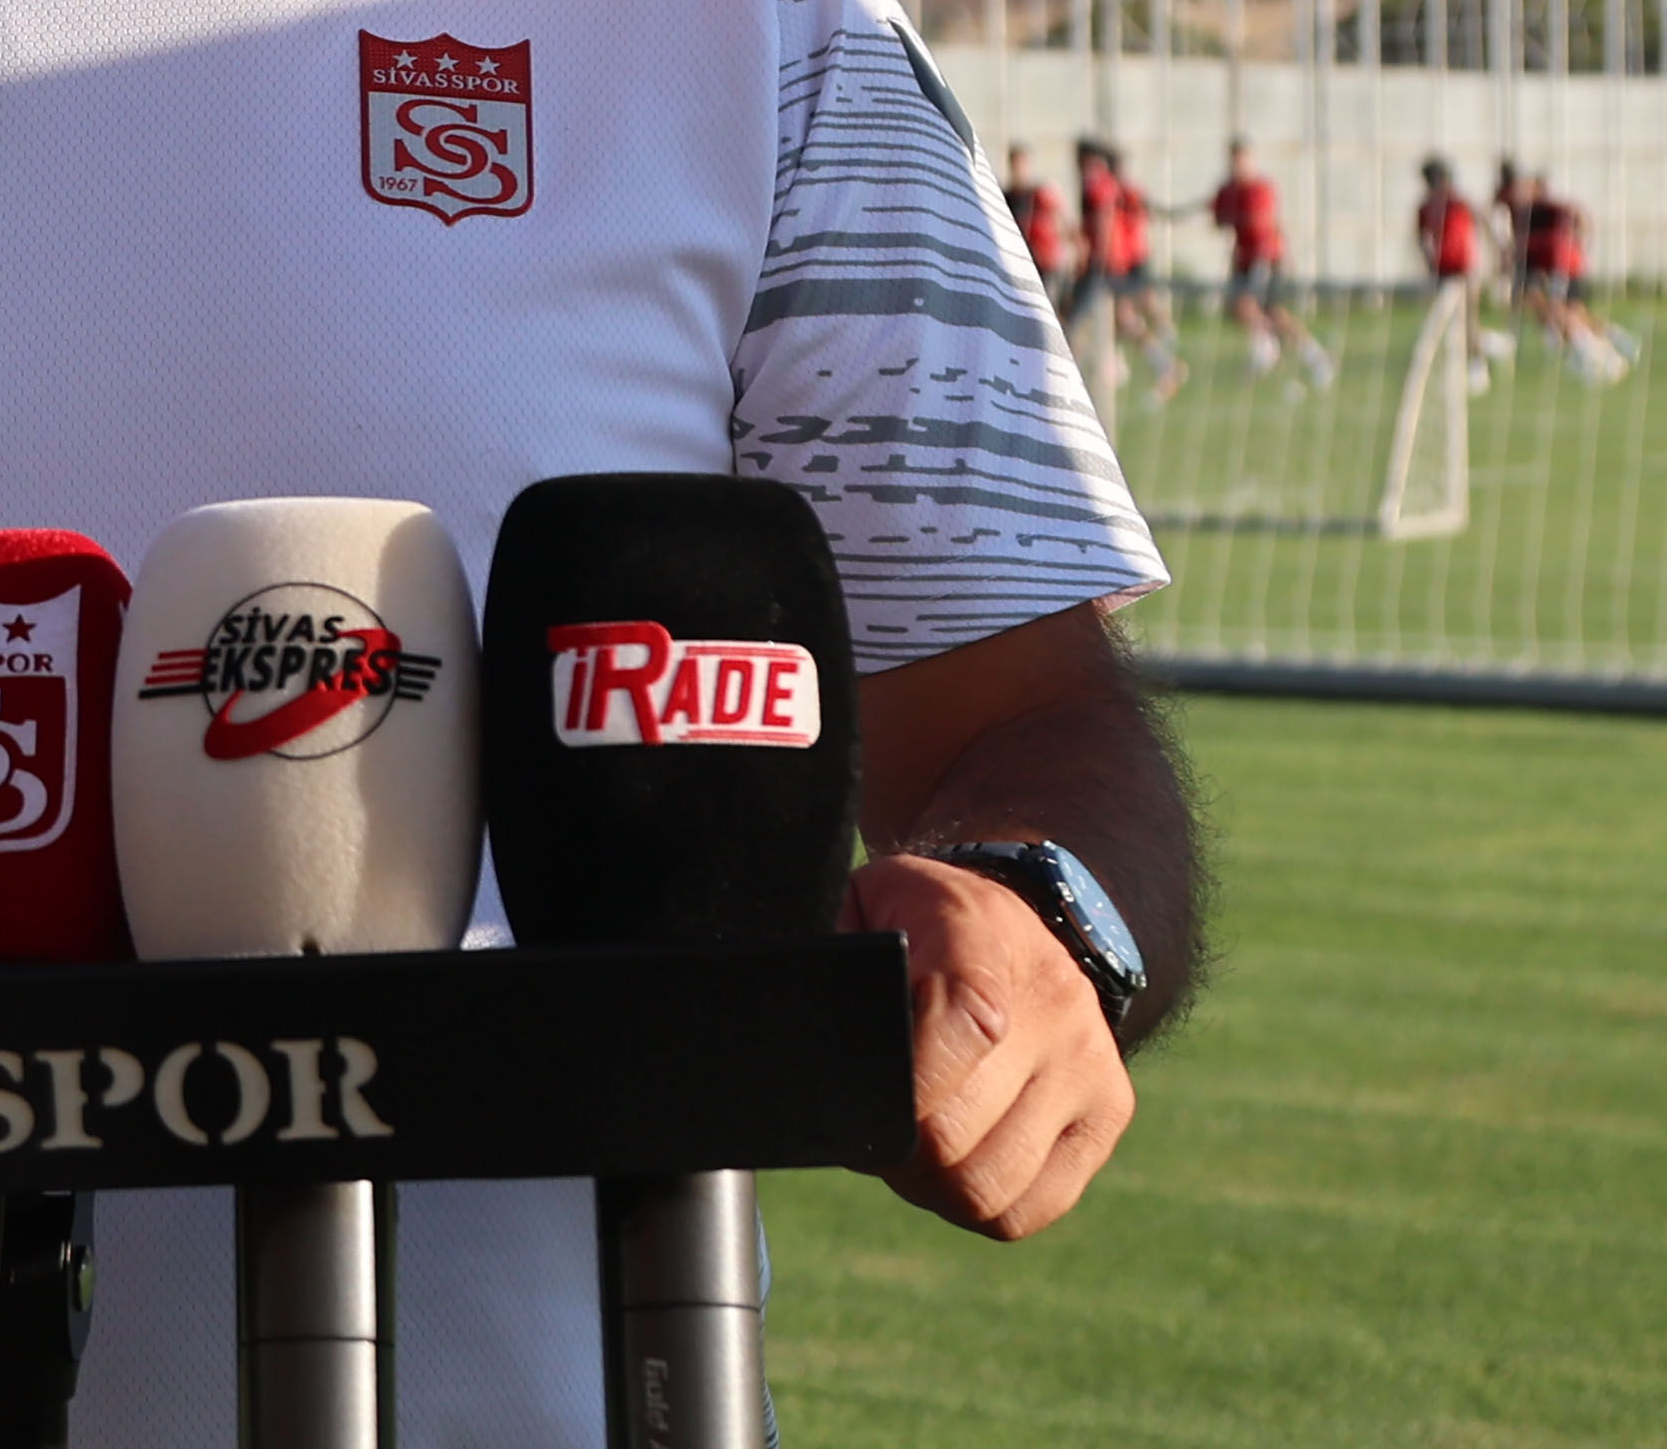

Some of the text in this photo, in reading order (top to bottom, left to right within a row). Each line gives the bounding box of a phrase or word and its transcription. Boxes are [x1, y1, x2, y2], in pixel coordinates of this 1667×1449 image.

[372, 67, 521, 95] SİVASSPOR
[378, 175, 418, 193] 1967
[219, 606, 345, 645] SİVAS
[200, 646, 399, 696] EKSPRES
